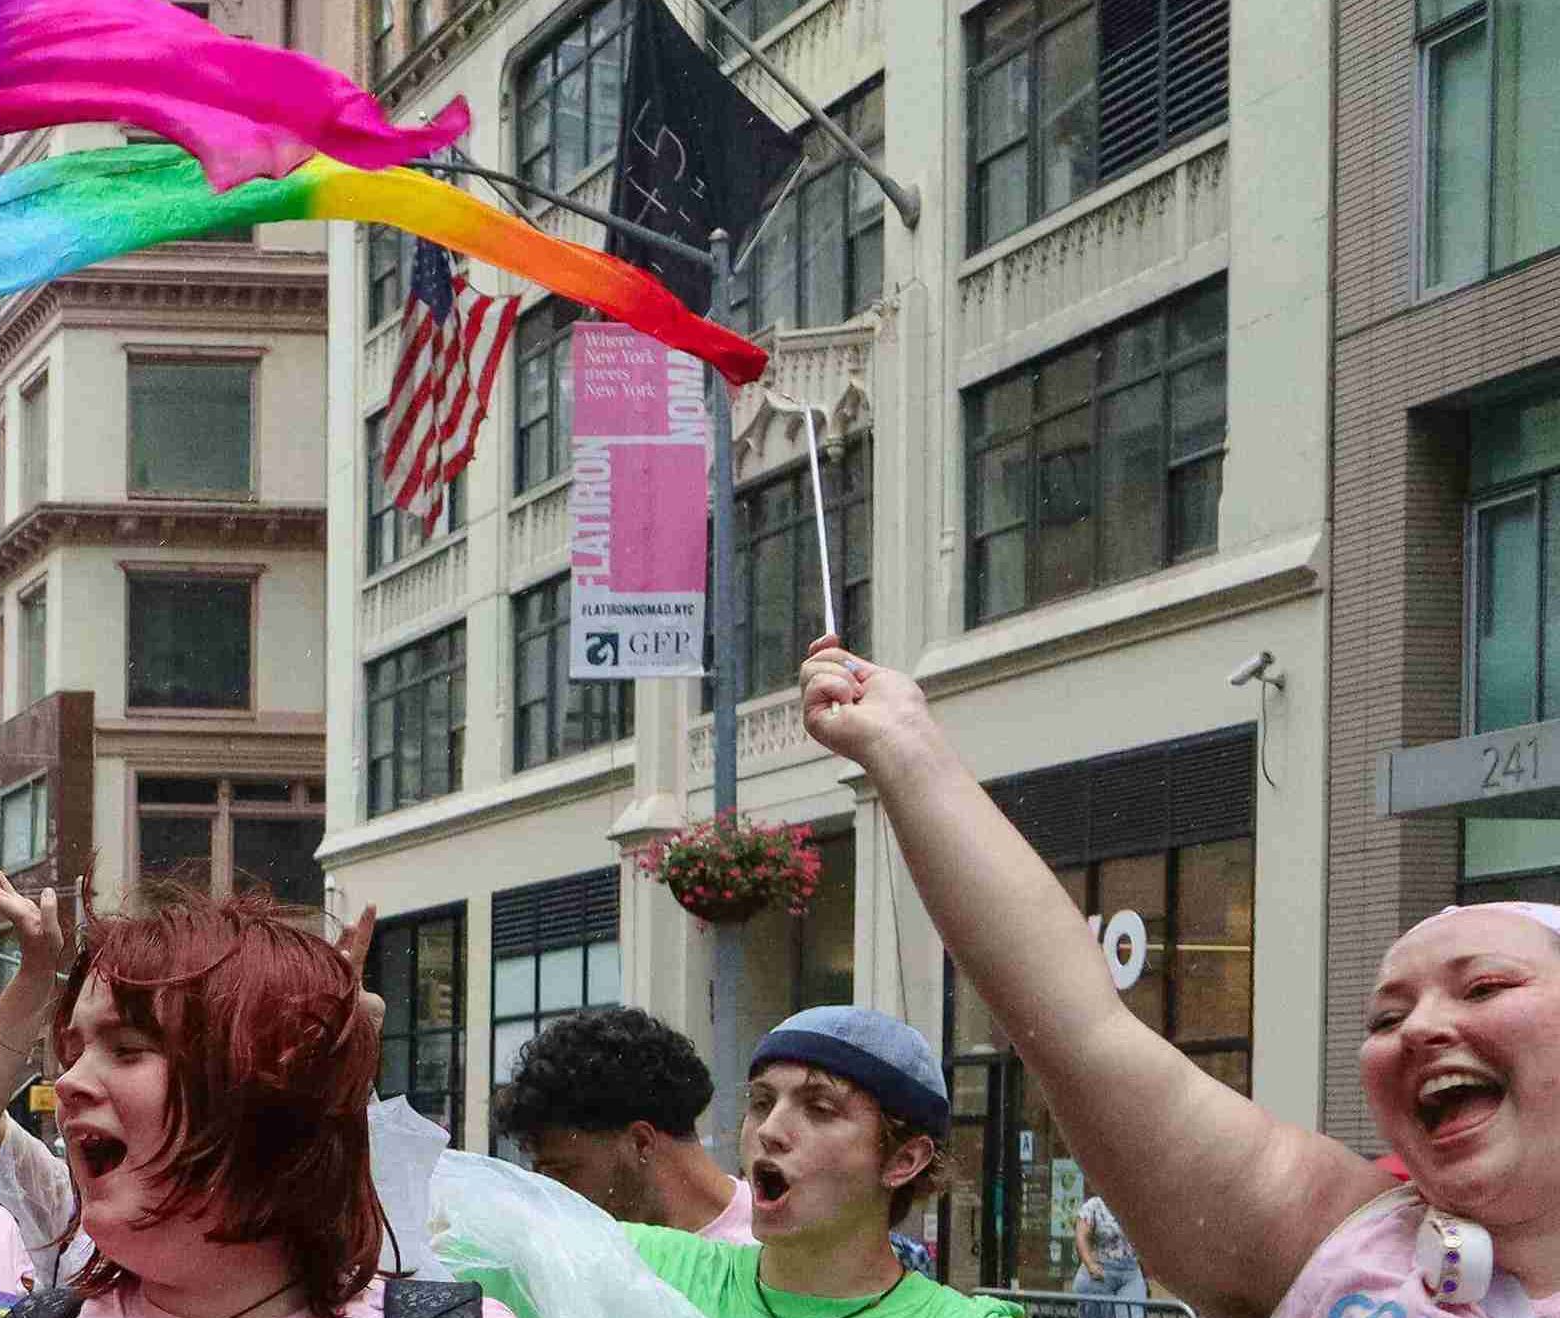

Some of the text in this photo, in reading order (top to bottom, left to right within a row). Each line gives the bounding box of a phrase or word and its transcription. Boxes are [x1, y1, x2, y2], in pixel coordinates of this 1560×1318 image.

[584, 331, 635, 347] Where
[584, 350, 656, 363] New York
[584, 368, 630, 380] meets
[584, 382, 656, 398] New York
[570, 437, 610, 589] FLATIRON
[629, 631, 690, 654] GFP
[1480, 736, 1539, 789] 241
